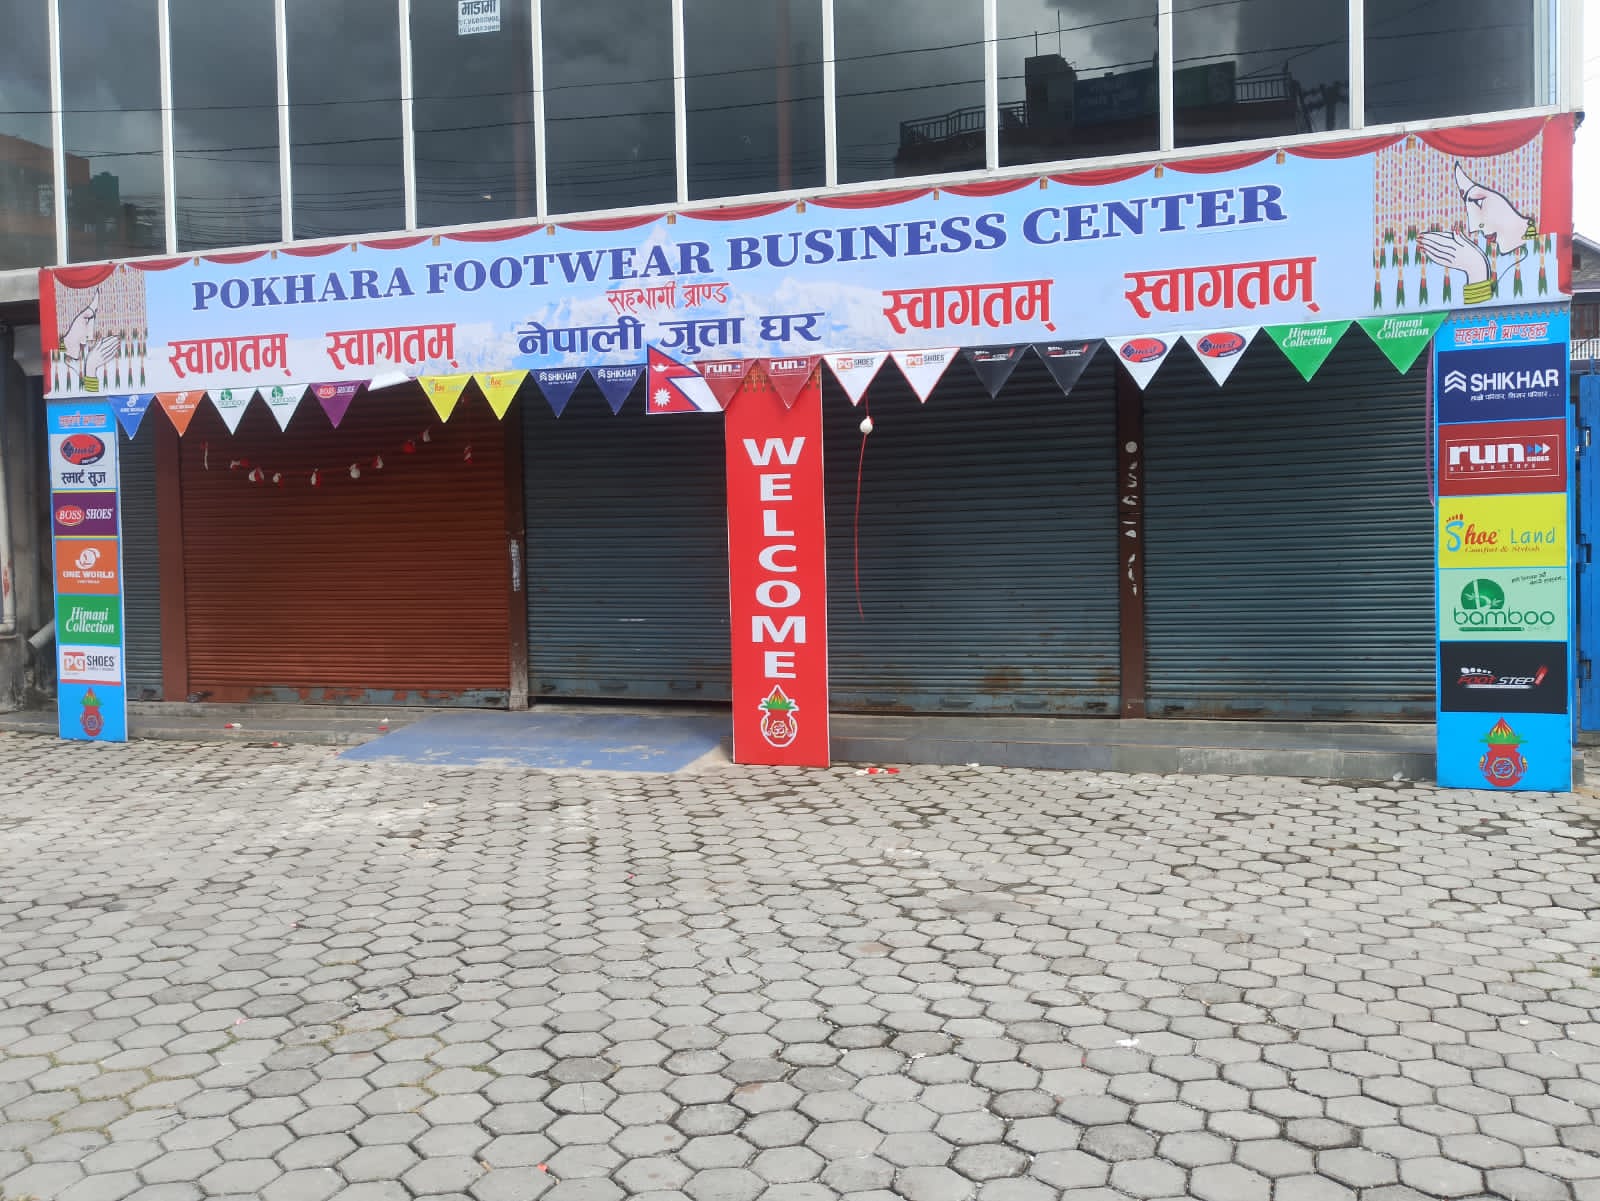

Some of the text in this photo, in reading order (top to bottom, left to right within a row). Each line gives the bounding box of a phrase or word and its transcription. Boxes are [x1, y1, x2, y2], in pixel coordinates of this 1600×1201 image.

[192, 185, 1288, 311] POKHARA FOOTWEAR BUSINESS CENTER
[1124, 257, 1320, 319] स्वागतम्
[605, 281, 676, 315] सहभागी
[882, 279, 1056, 334] स्वागतम्
[1383, 317, 1423, 330] Himani
[518, 315, 646, 355] नेपाली
[759, 312, 826, 342] घर
[1288, 326, 1327, 338] Himani
[1377, 327, 1429, 339] Collection
[326, 323, 458, 369] स्वागतम्
[1282, 336, 1332, 347] Collection
[168, 333, 289, 378] स्वागतम्
[706, 363, 732, 374] run
[771, 360, 797, 370] run
[548, 371, 577, 382] SHIKHAR
[607, 369, 637, 379] SHIKHAR
[1470, 369, 1559, 392] SHIKHAR
[1448, 443, 1525, 466] run
[61, 469, 85, 485] स्मार्ट
[58, 508, 112, 521] BOSS SHOES
[1446, 520, 1555, 552] Shoe Land
[742, 436, 807, 679] WELCOME
[82, 570, 114, 579] WORLD
[70, 606, 109, 622] Himani
[1454, 607, 1555, 626] bamboo
[66, 619, 115, 633] Collection
[64, 654, 114, 671] PG SHOES
[1497, 676, 1535, 685] STEP
